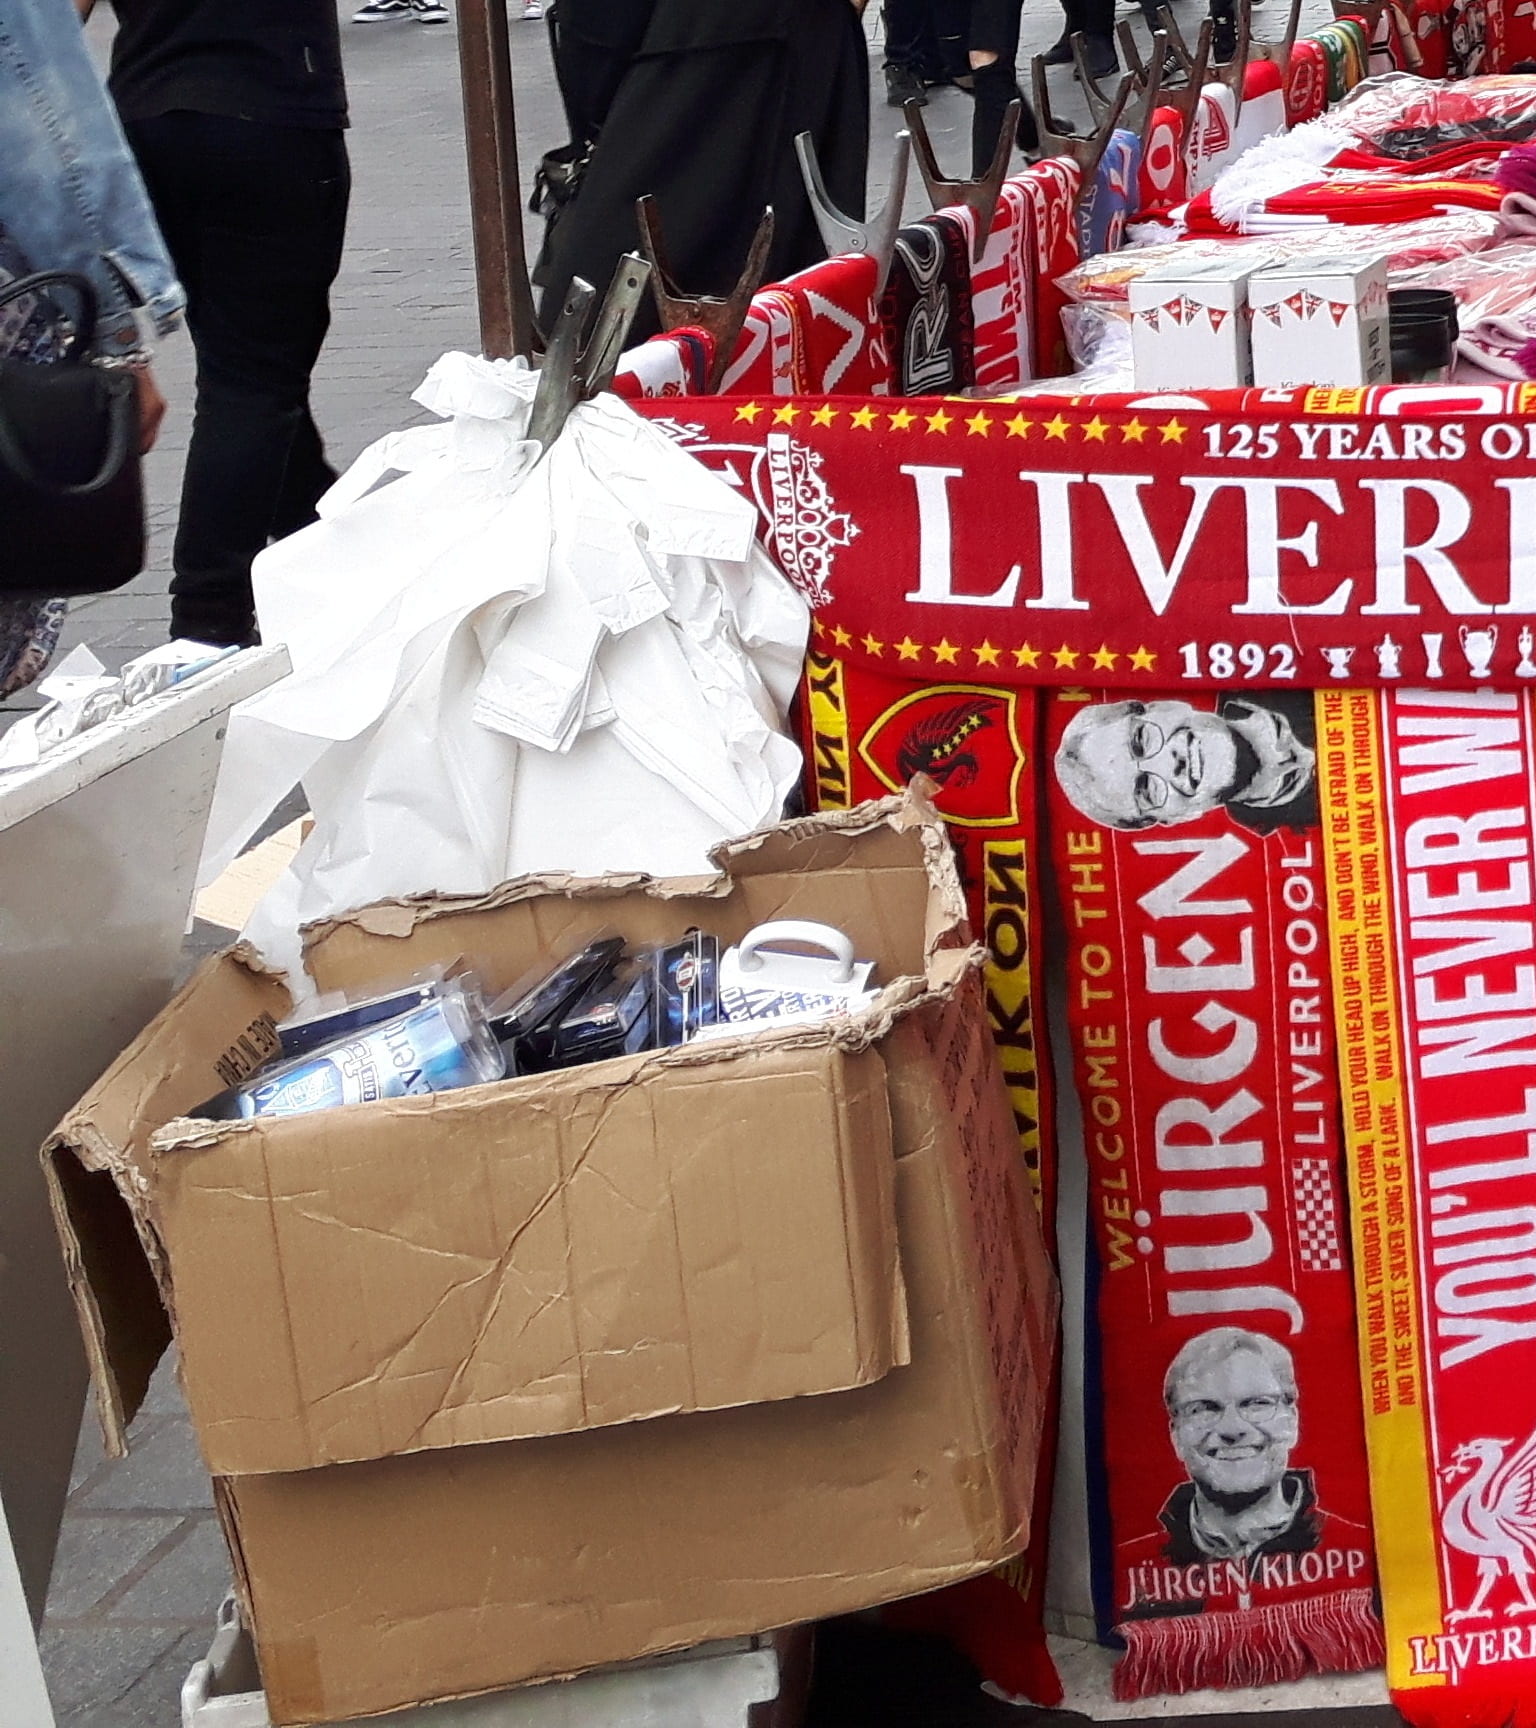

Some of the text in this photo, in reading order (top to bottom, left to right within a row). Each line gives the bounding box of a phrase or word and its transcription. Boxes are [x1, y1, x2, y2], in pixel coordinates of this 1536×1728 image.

[1204, 423, 1278, 460] 125
[1288, 423, 1464, 460] YEARS
[1180, 641, 1296, 680] 1892
[1067, 831, 1134, 1272] WELCOME TO THE
[1280, 840, 1325, 1144] LIVERPOOL
[1131, 832, 1304, 1336] JÜRGEN
[1123, 1548, 1365, 1610] JÜRGEN KLOPP
